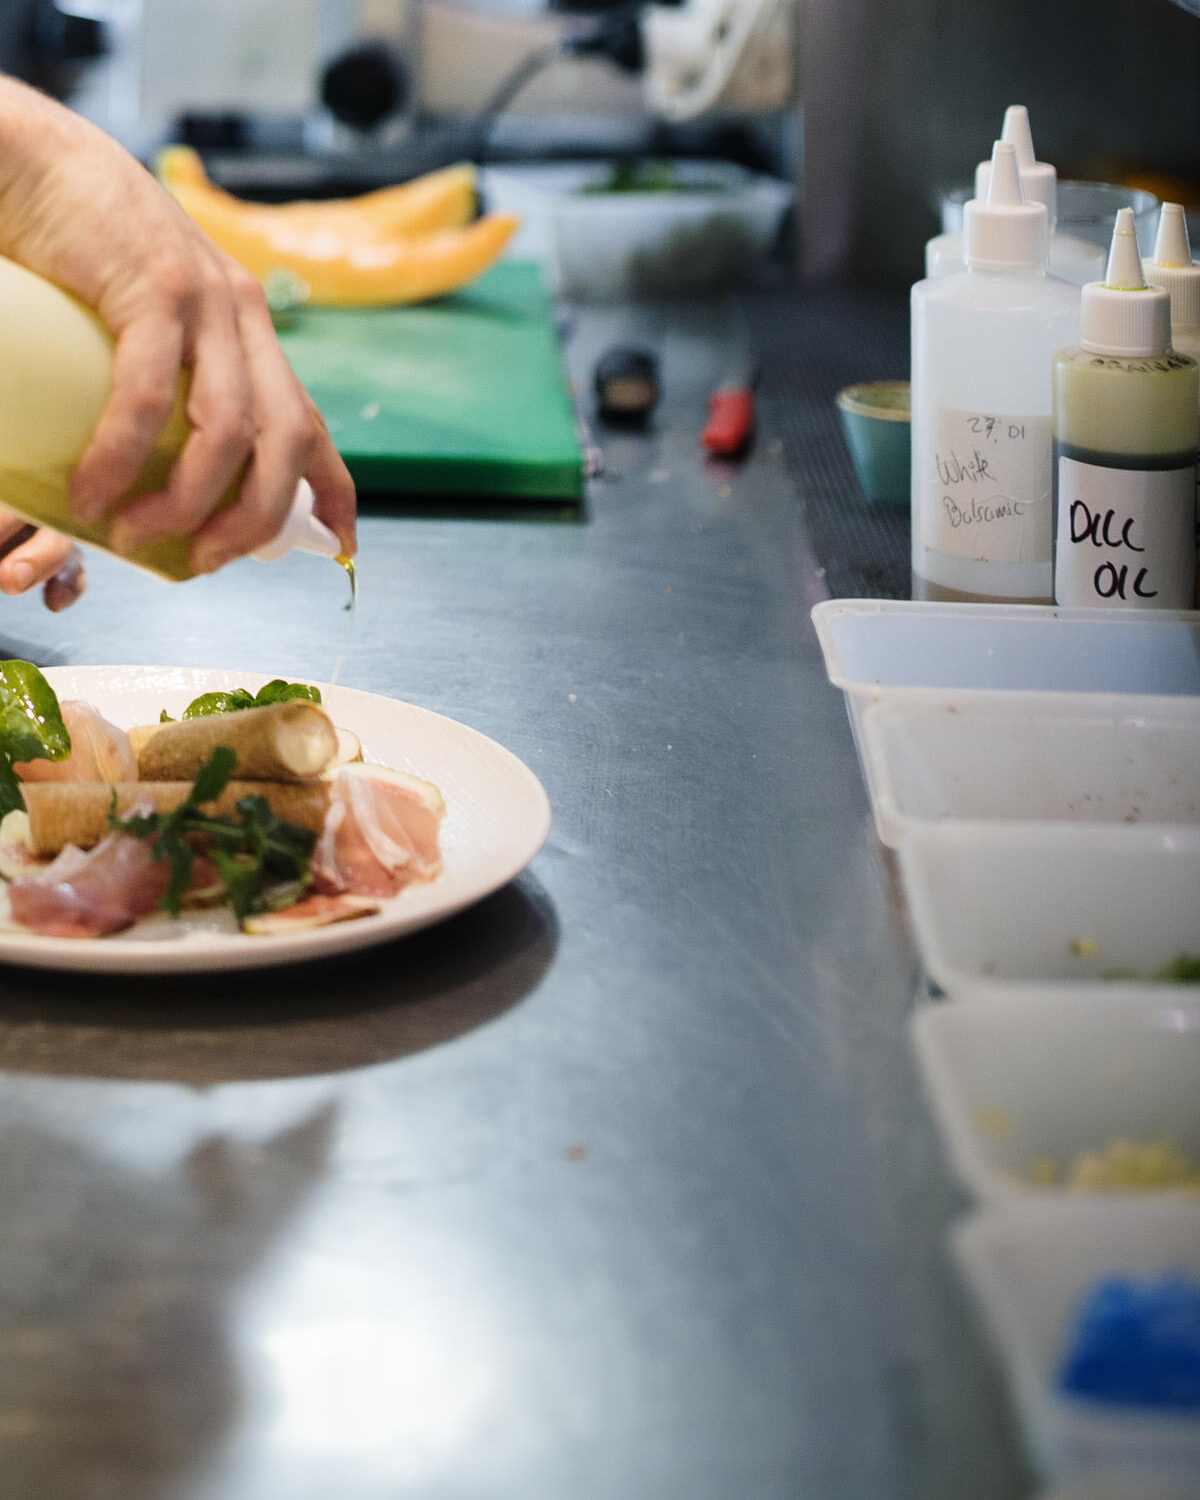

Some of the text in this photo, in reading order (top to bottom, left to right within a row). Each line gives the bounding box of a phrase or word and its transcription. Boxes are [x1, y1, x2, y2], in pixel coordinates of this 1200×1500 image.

[935, 449, 997, 486] White
[943, 496, 1025, 528] Balsamic
[1094, 561, 1158, 600] OIL
